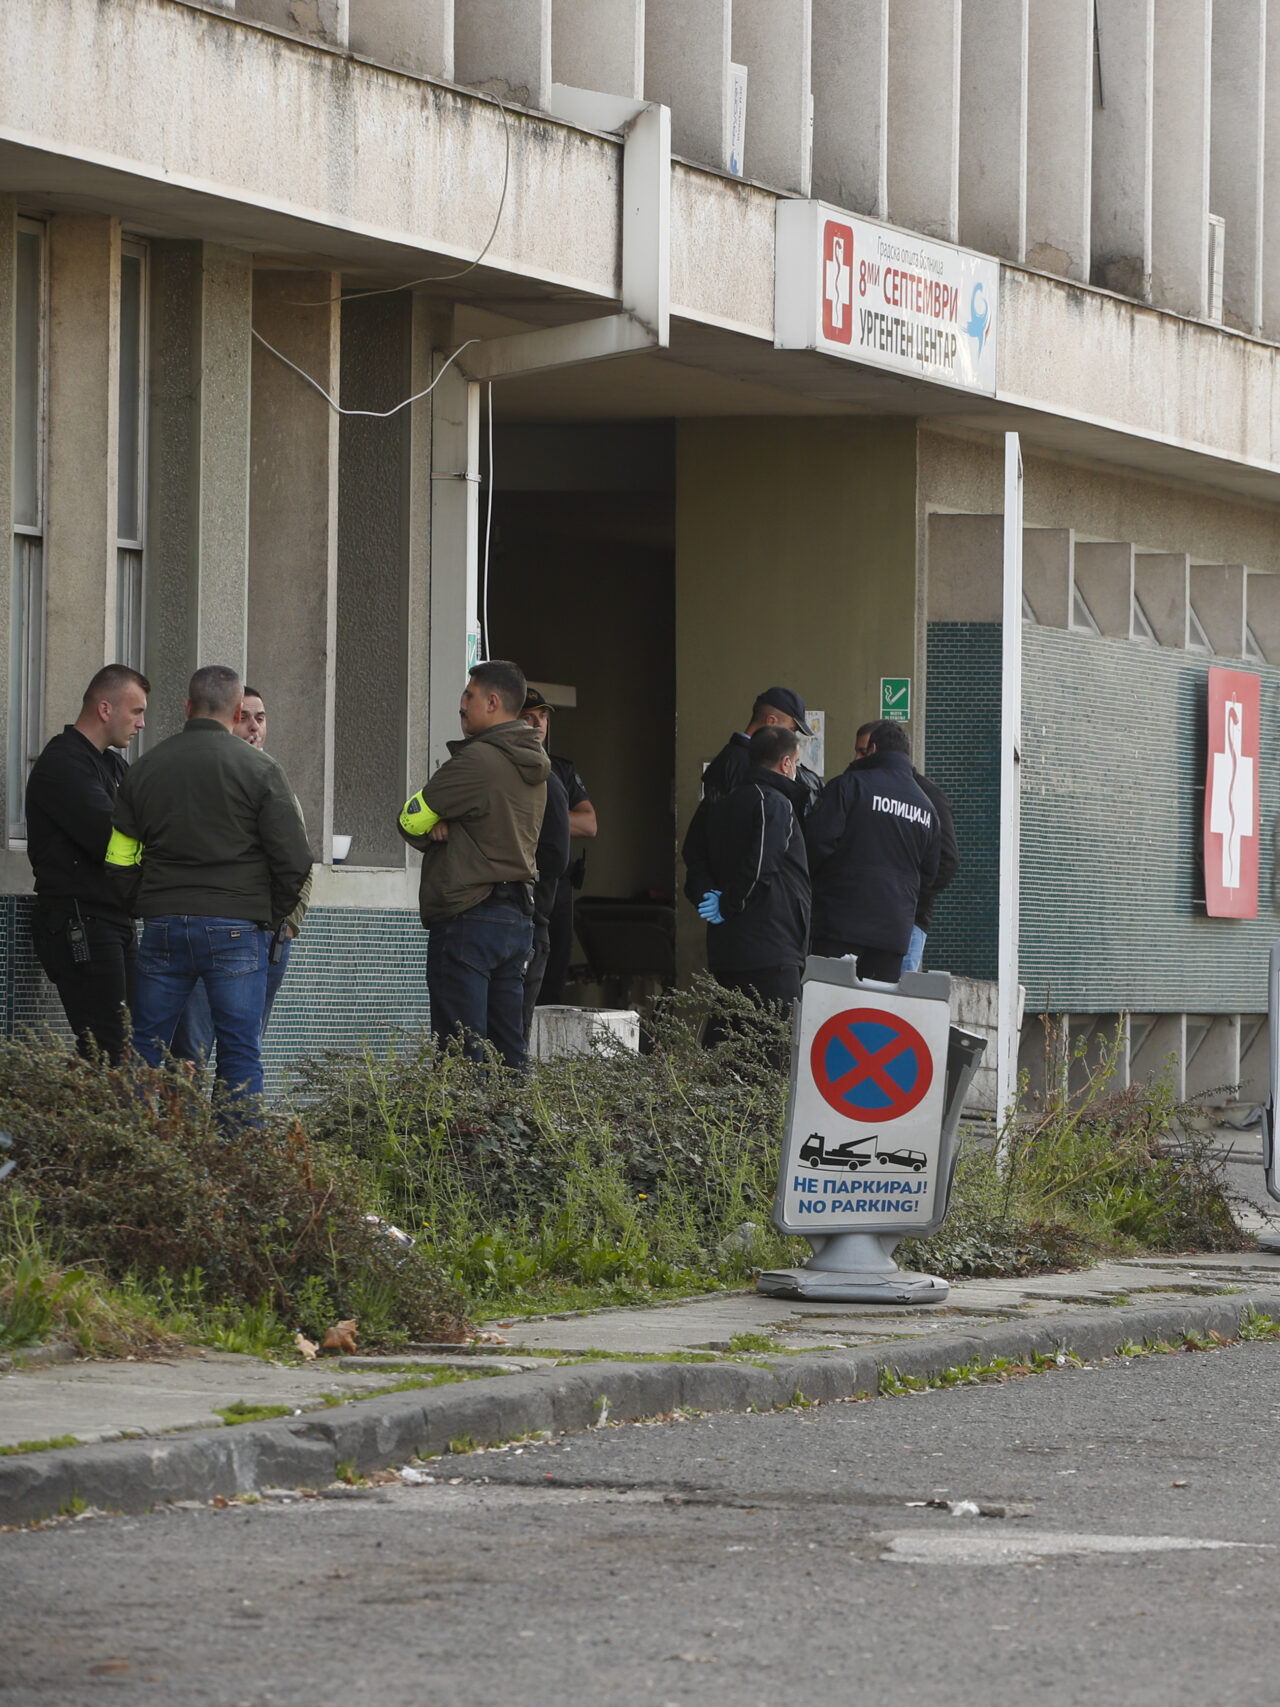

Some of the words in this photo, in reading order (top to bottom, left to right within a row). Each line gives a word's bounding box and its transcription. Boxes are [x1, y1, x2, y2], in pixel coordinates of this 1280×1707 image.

[883, 267, 959, 324] СЕПТЕМВРИ
[860, 308, 914, 358] УРГЕНТЕН
[916, 324, 957, 370] ЦЕНТАР
[872, 795, 931, 829] ПОЛИЦИЈА
[793, 1175, 818, 1194] НЕ
[823, 1179, 928, 1194] ПАРКИРАЈ!
[798, 1199, 827, 1214] NO
[831, 1199, 919, 1213] PARKING!
